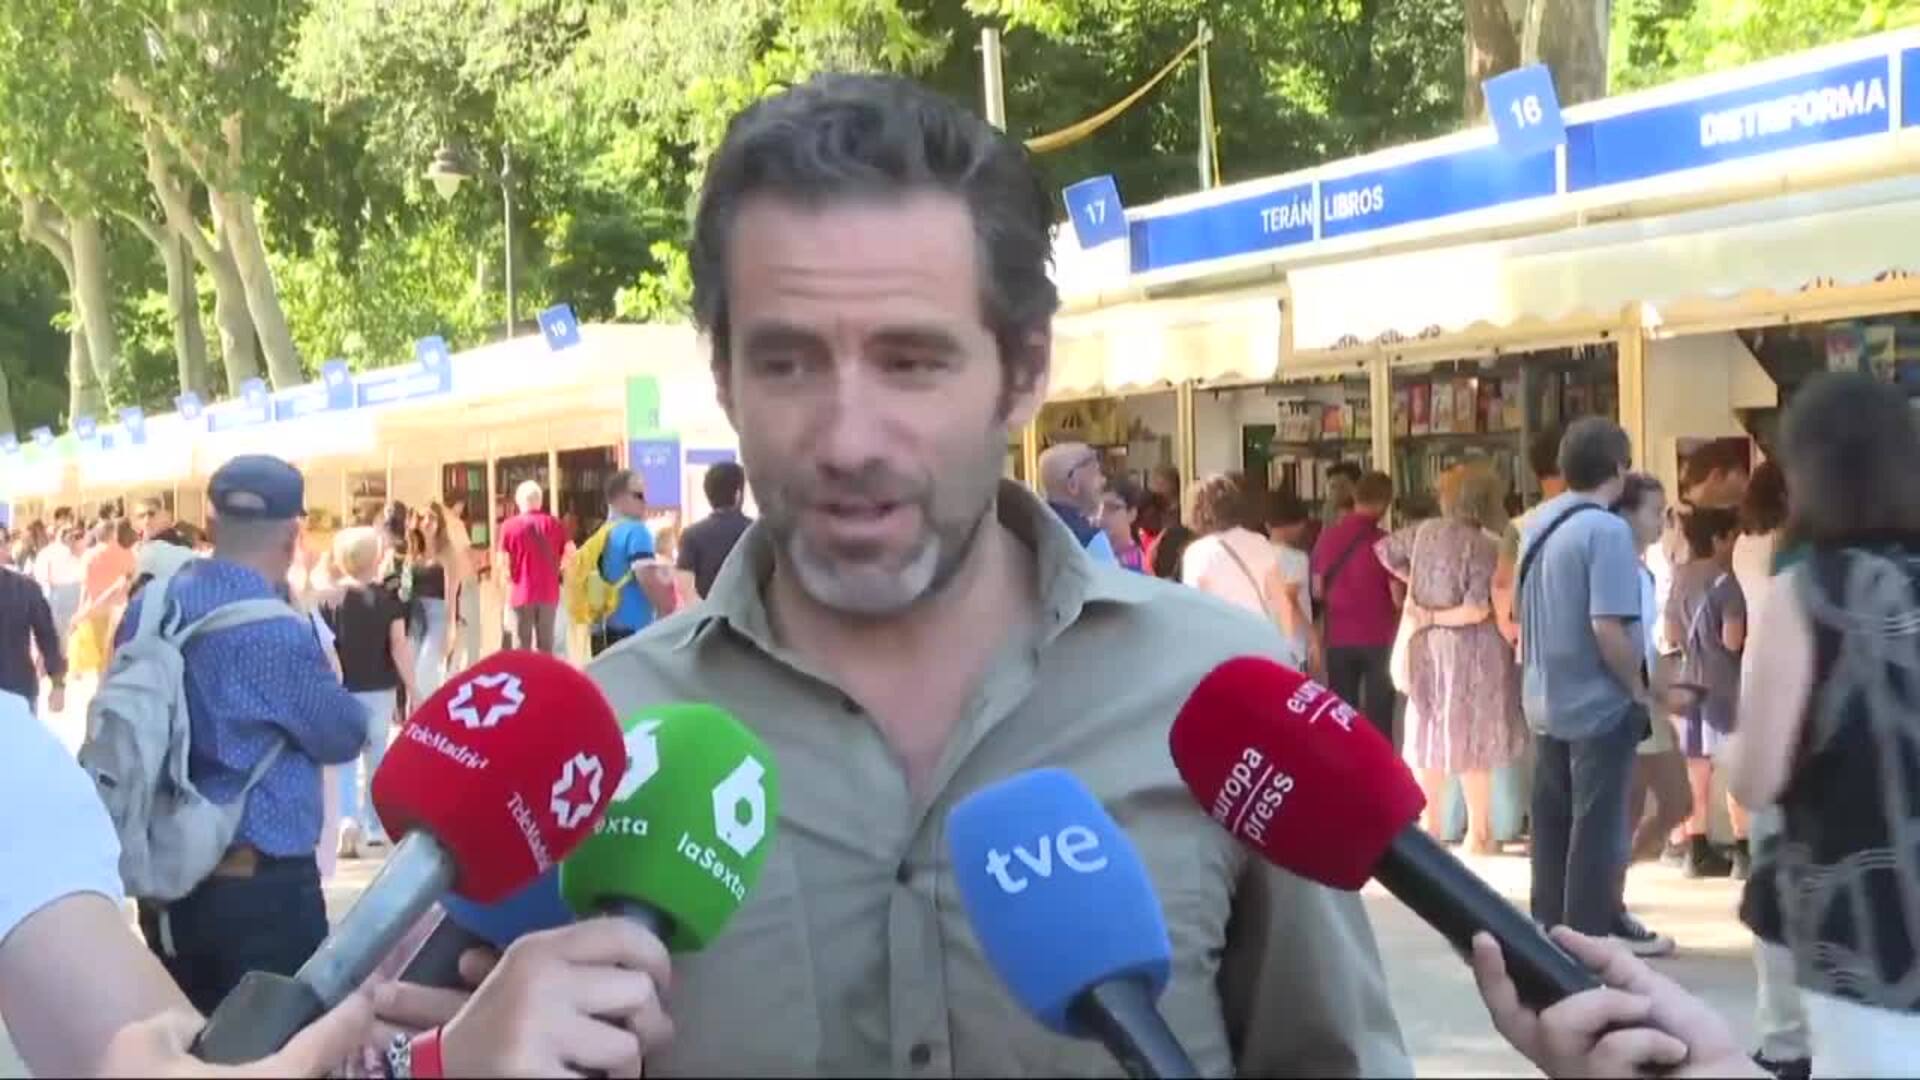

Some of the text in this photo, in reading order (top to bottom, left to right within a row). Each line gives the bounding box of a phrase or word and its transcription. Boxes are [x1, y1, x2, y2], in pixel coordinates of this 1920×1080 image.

[1510, 94, 1543, 130] 16
[1083, 200, 1106, 227] 17
[1261, 184, 1384, 234] TERÁN LIBROS
[405, 722, 490, 769] TeleMadrid
[1243, 772, 1295, 847] press
[676, 831, 747, 902] laSexta
[985, 825, 1109, 894] tve
